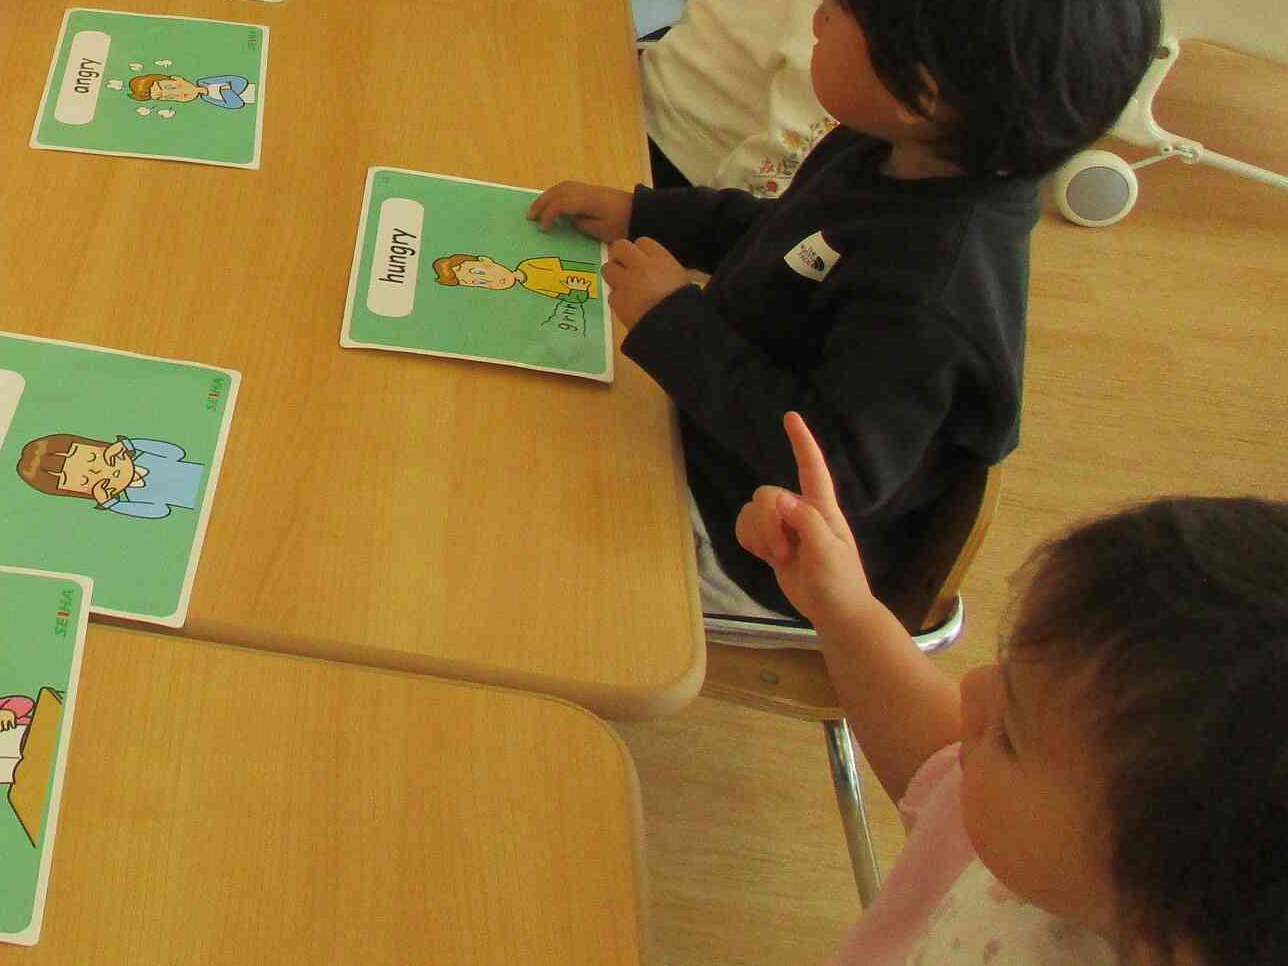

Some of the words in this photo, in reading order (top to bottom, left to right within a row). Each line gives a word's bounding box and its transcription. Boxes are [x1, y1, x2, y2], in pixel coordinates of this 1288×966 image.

[74, 57, 103, 94] angry
[378, 227, 417, 284] hungry
[55, 589, 74, 638] SEIHA
